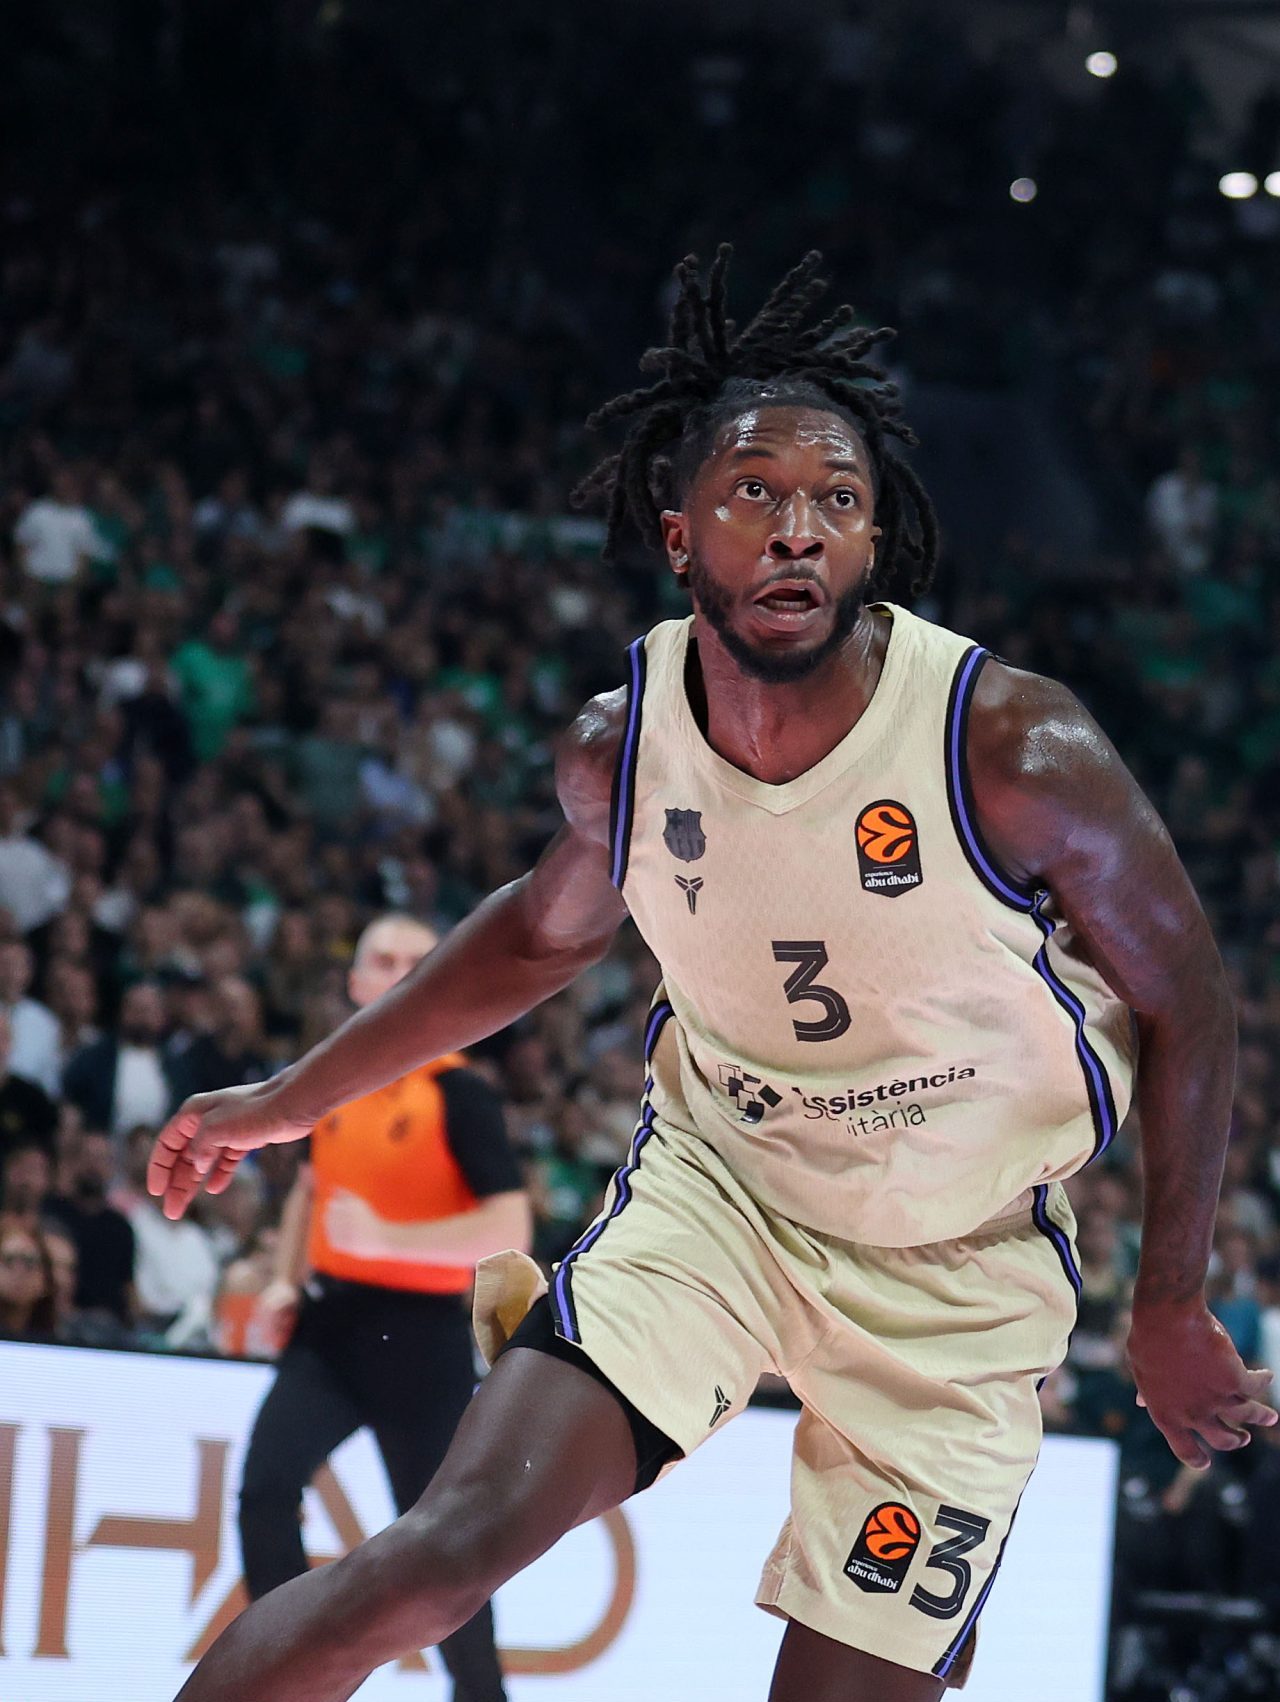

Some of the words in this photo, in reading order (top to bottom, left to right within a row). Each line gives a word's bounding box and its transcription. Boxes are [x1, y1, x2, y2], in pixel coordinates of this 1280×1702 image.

[865, 877, 886, 888] abu
[887, 872, 920, 887] dhabi
[771, 940, 852, 1043] 3
[791, 1066, 977, 1115] ssistència
[846, 1564, 868, 1579] abu
[867, 1569, 900, 1591] dhabi
[907, 1503, 993, 1621] 3
